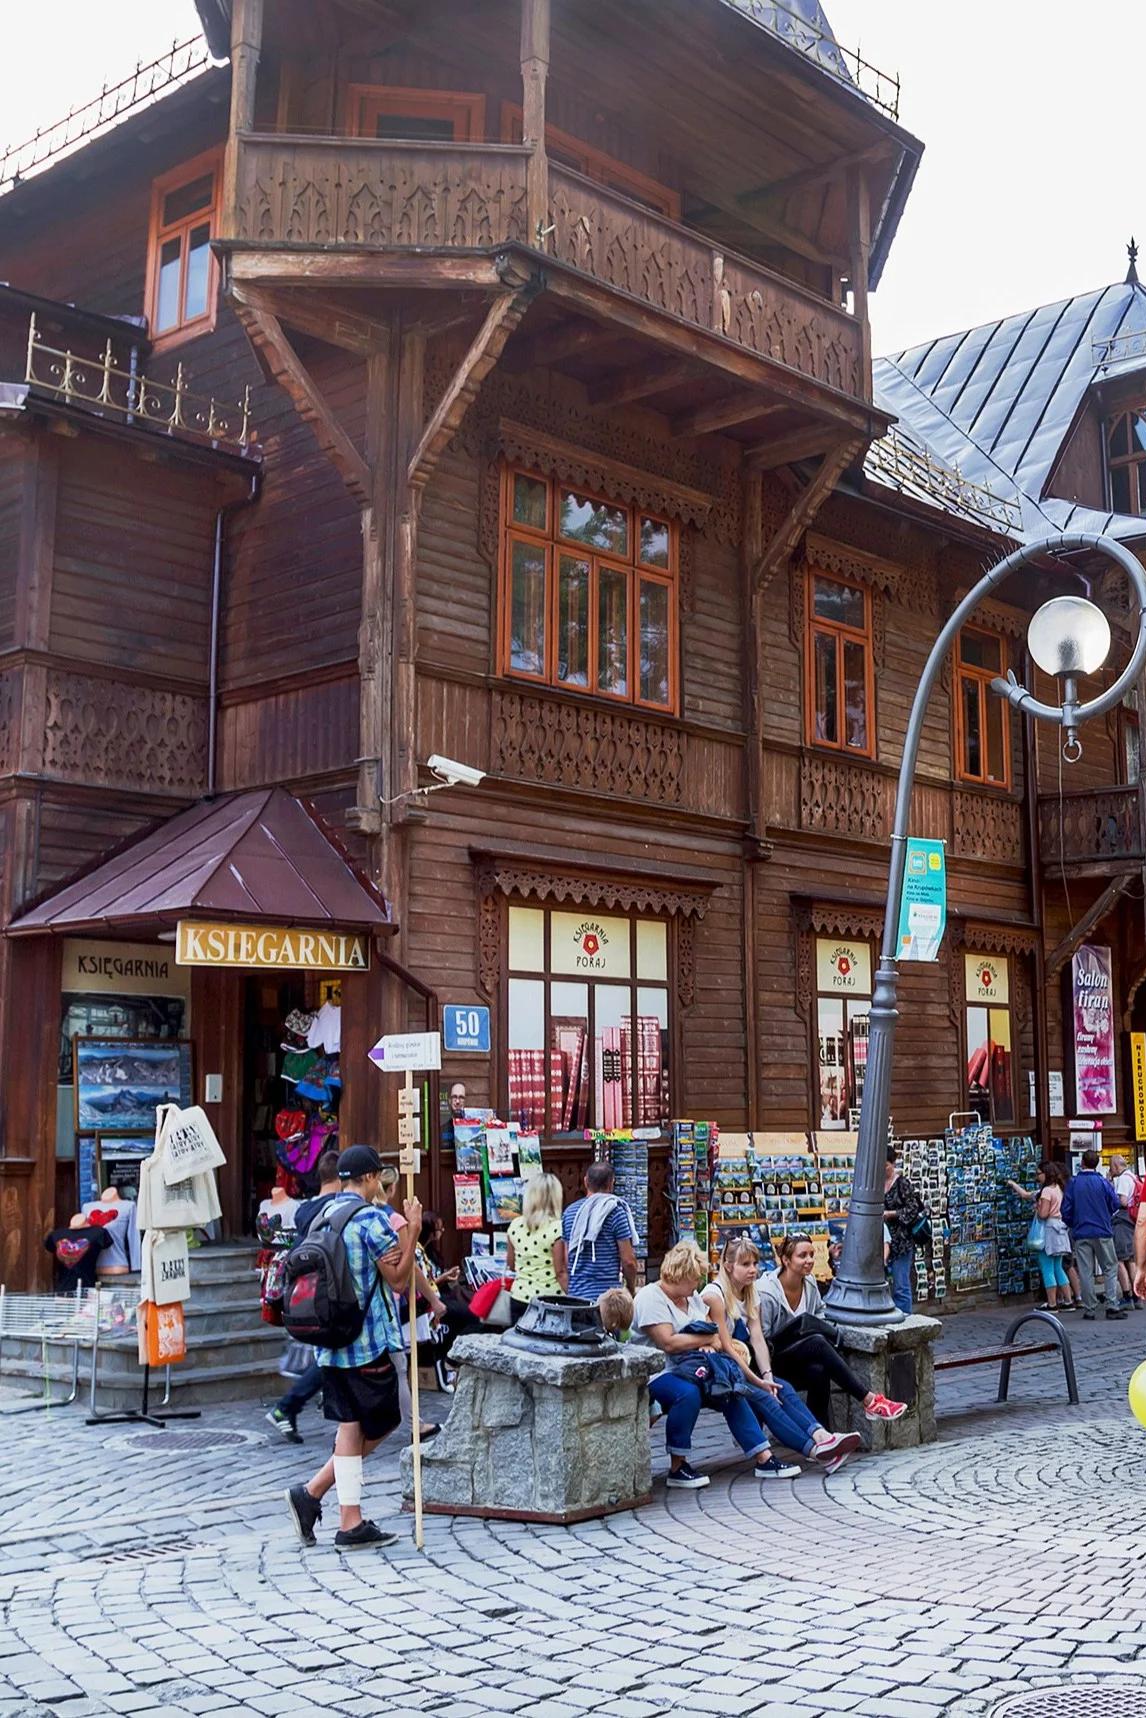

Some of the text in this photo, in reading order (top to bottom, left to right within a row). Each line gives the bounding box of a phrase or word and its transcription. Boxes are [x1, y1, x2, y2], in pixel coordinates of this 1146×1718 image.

[573, 922, 609, 945] KSIĘGARNIA
[184, 928, 366, 967] KSIĘGARNIA
[78, 955, 169, 980] KSIĘGARNIA
[576, 955, 606, 969] PORAJ
[1077, 968, 1109, 988] Salon
[1078, 990, 1109, 1009] firan
[455, 1011, 480, 1036] 50
